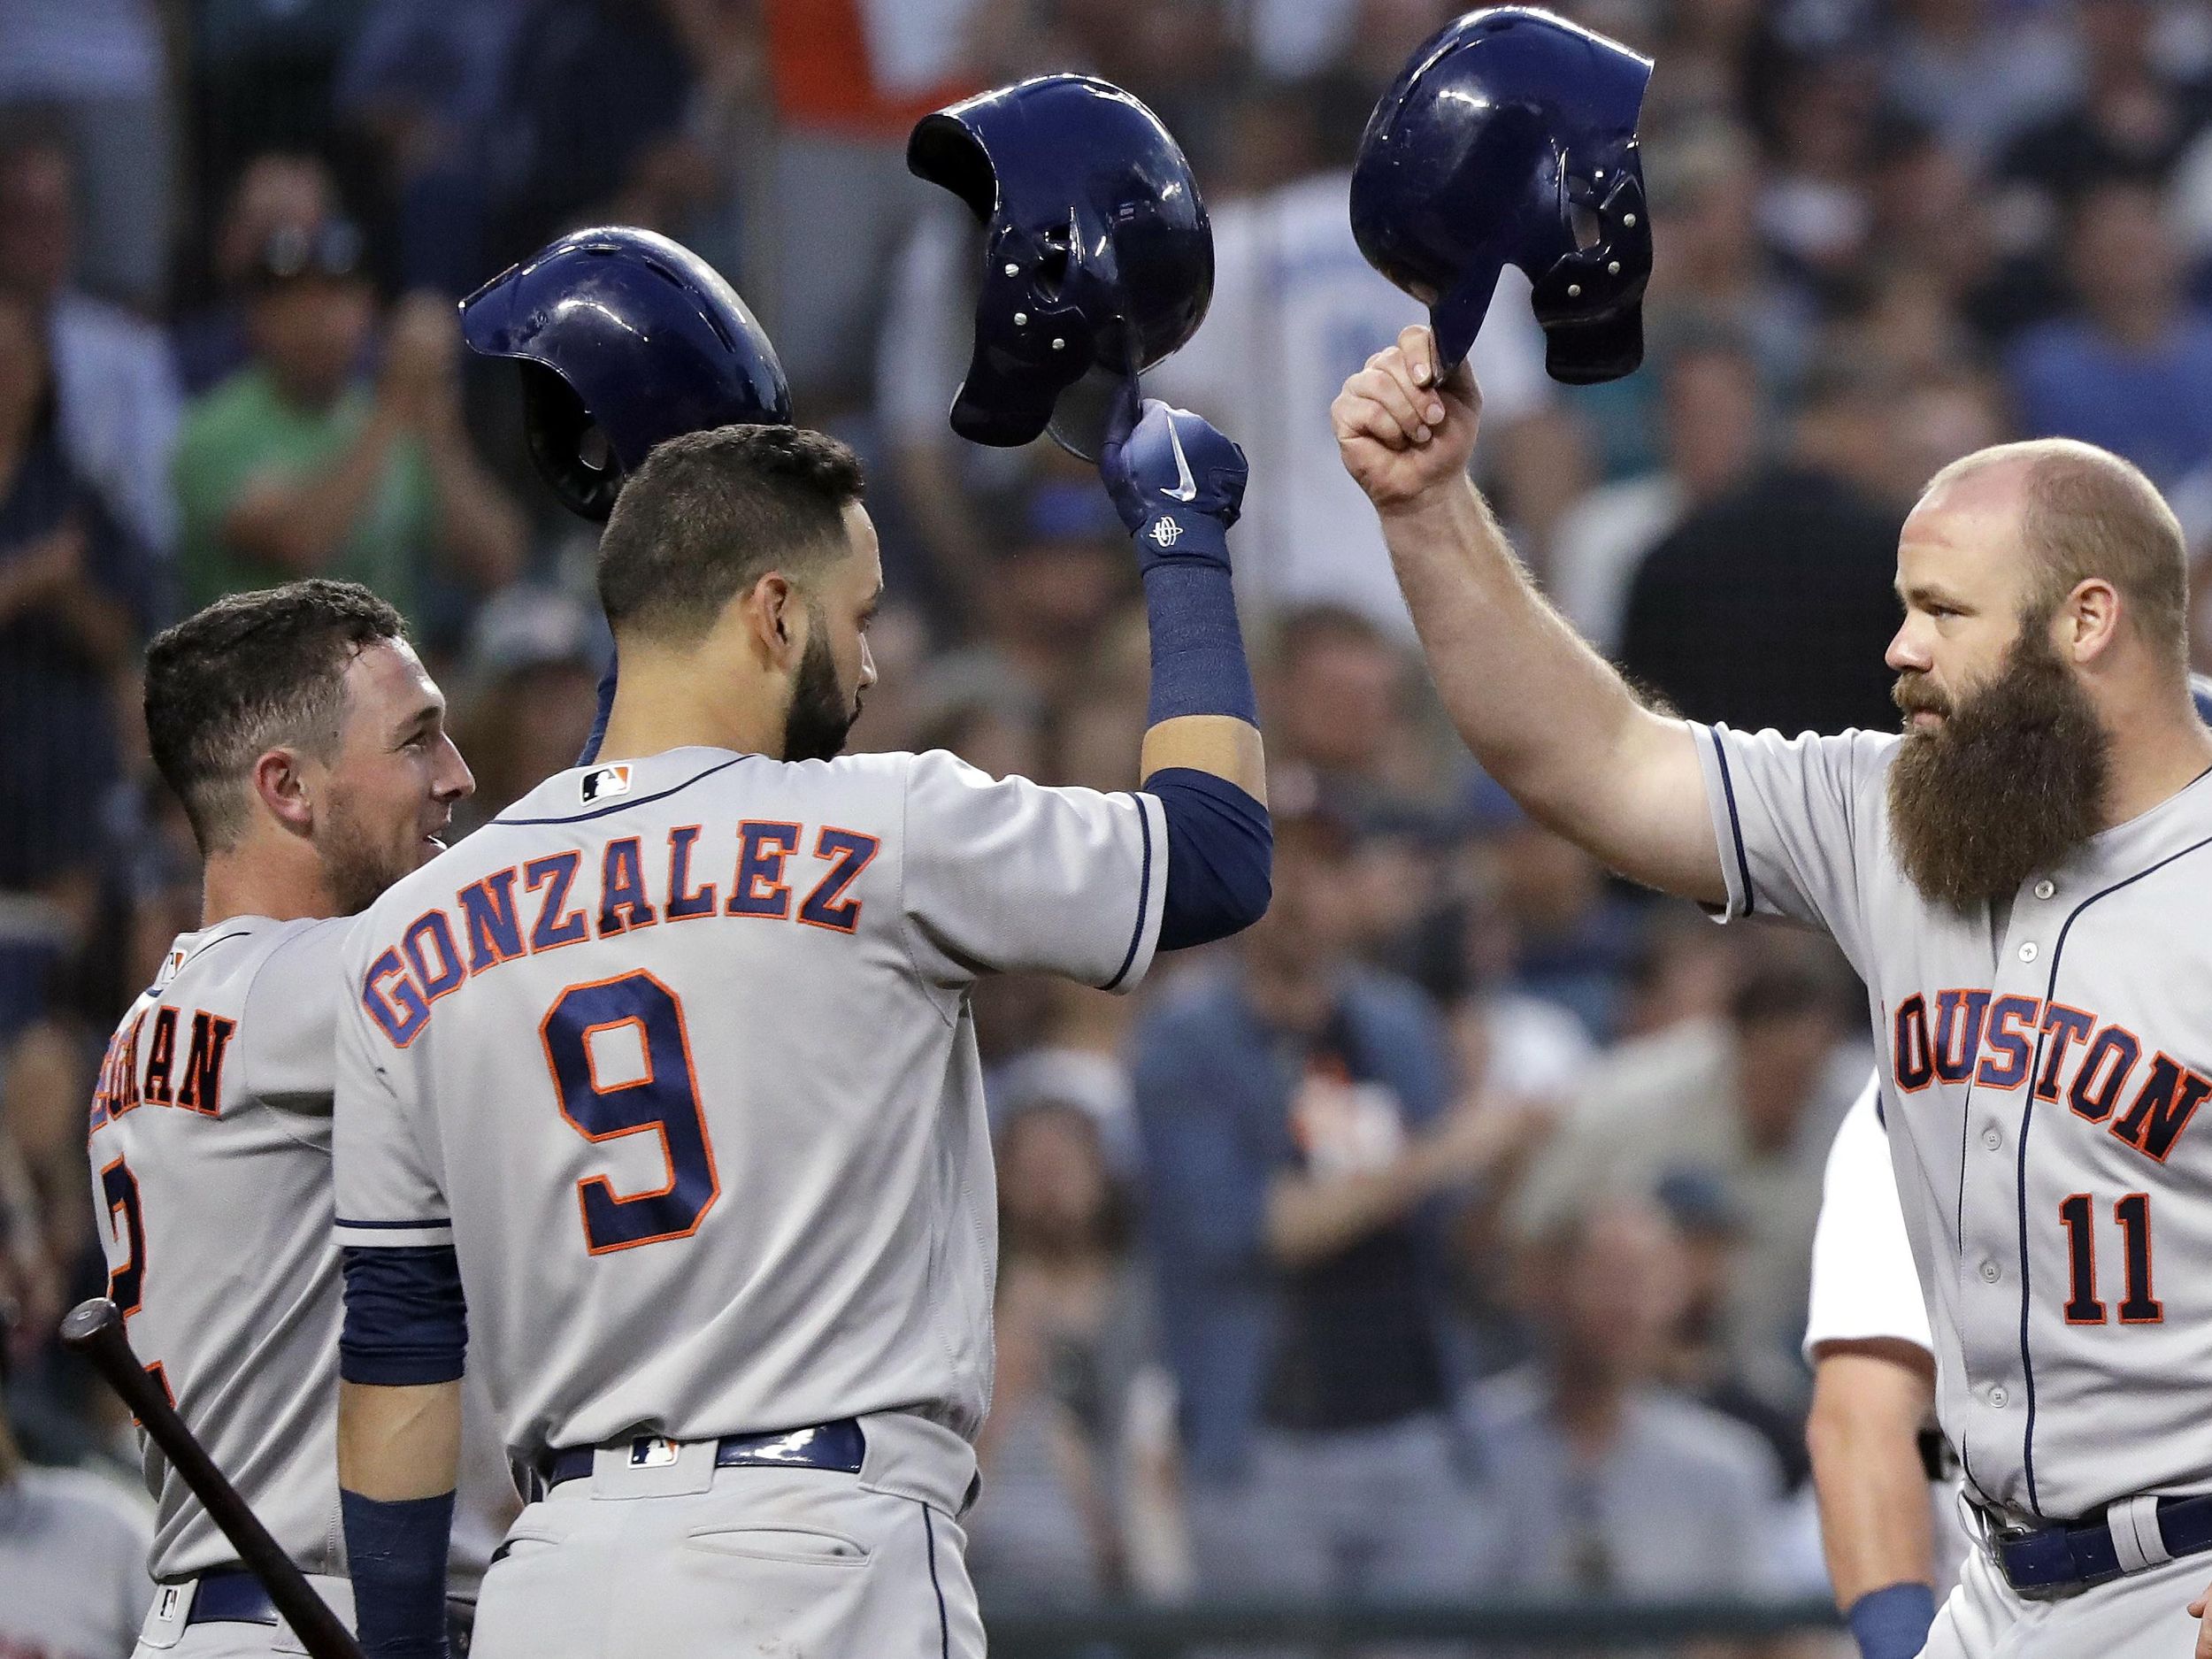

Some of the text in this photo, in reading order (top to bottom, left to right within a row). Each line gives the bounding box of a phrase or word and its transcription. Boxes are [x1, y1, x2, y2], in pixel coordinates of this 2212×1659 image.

[362, 819, 881, 1048] GONZALEZ
[539, 968, 720, 1256] 9
[1882, 989, 2212, 1164] OUSTON
[101, 1152, 177, 1427] 2
[2059, 1193, 2164, 1325] 11
